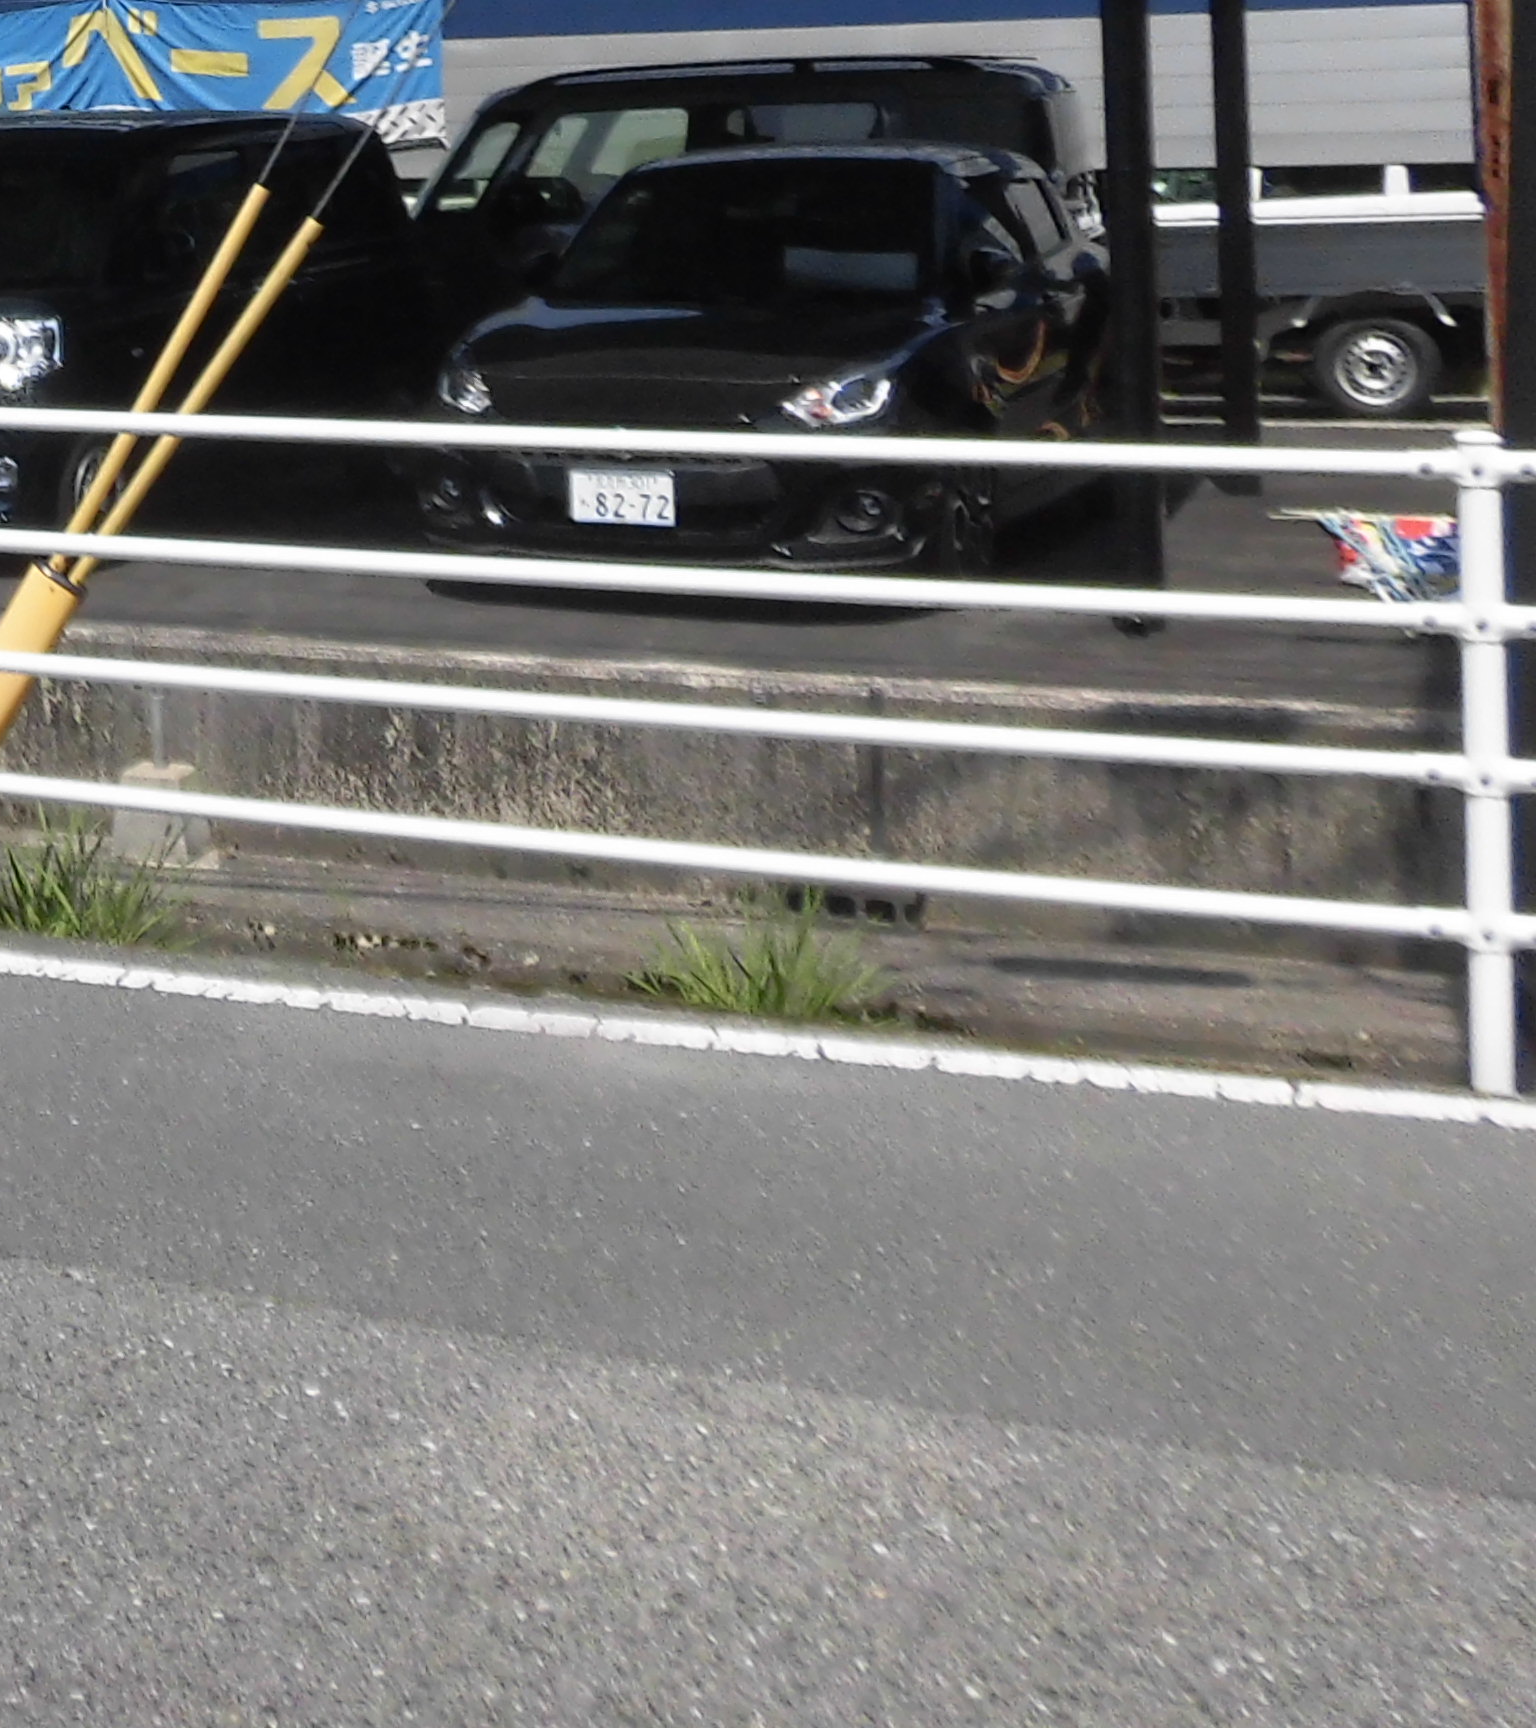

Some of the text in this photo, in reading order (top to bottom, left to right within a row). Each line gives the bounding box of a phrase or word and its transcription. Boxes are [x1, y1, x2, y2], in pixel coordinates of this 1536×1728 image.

[62, 11, 356, 110] ベース
[596, 492, 669, 520] 82-72
